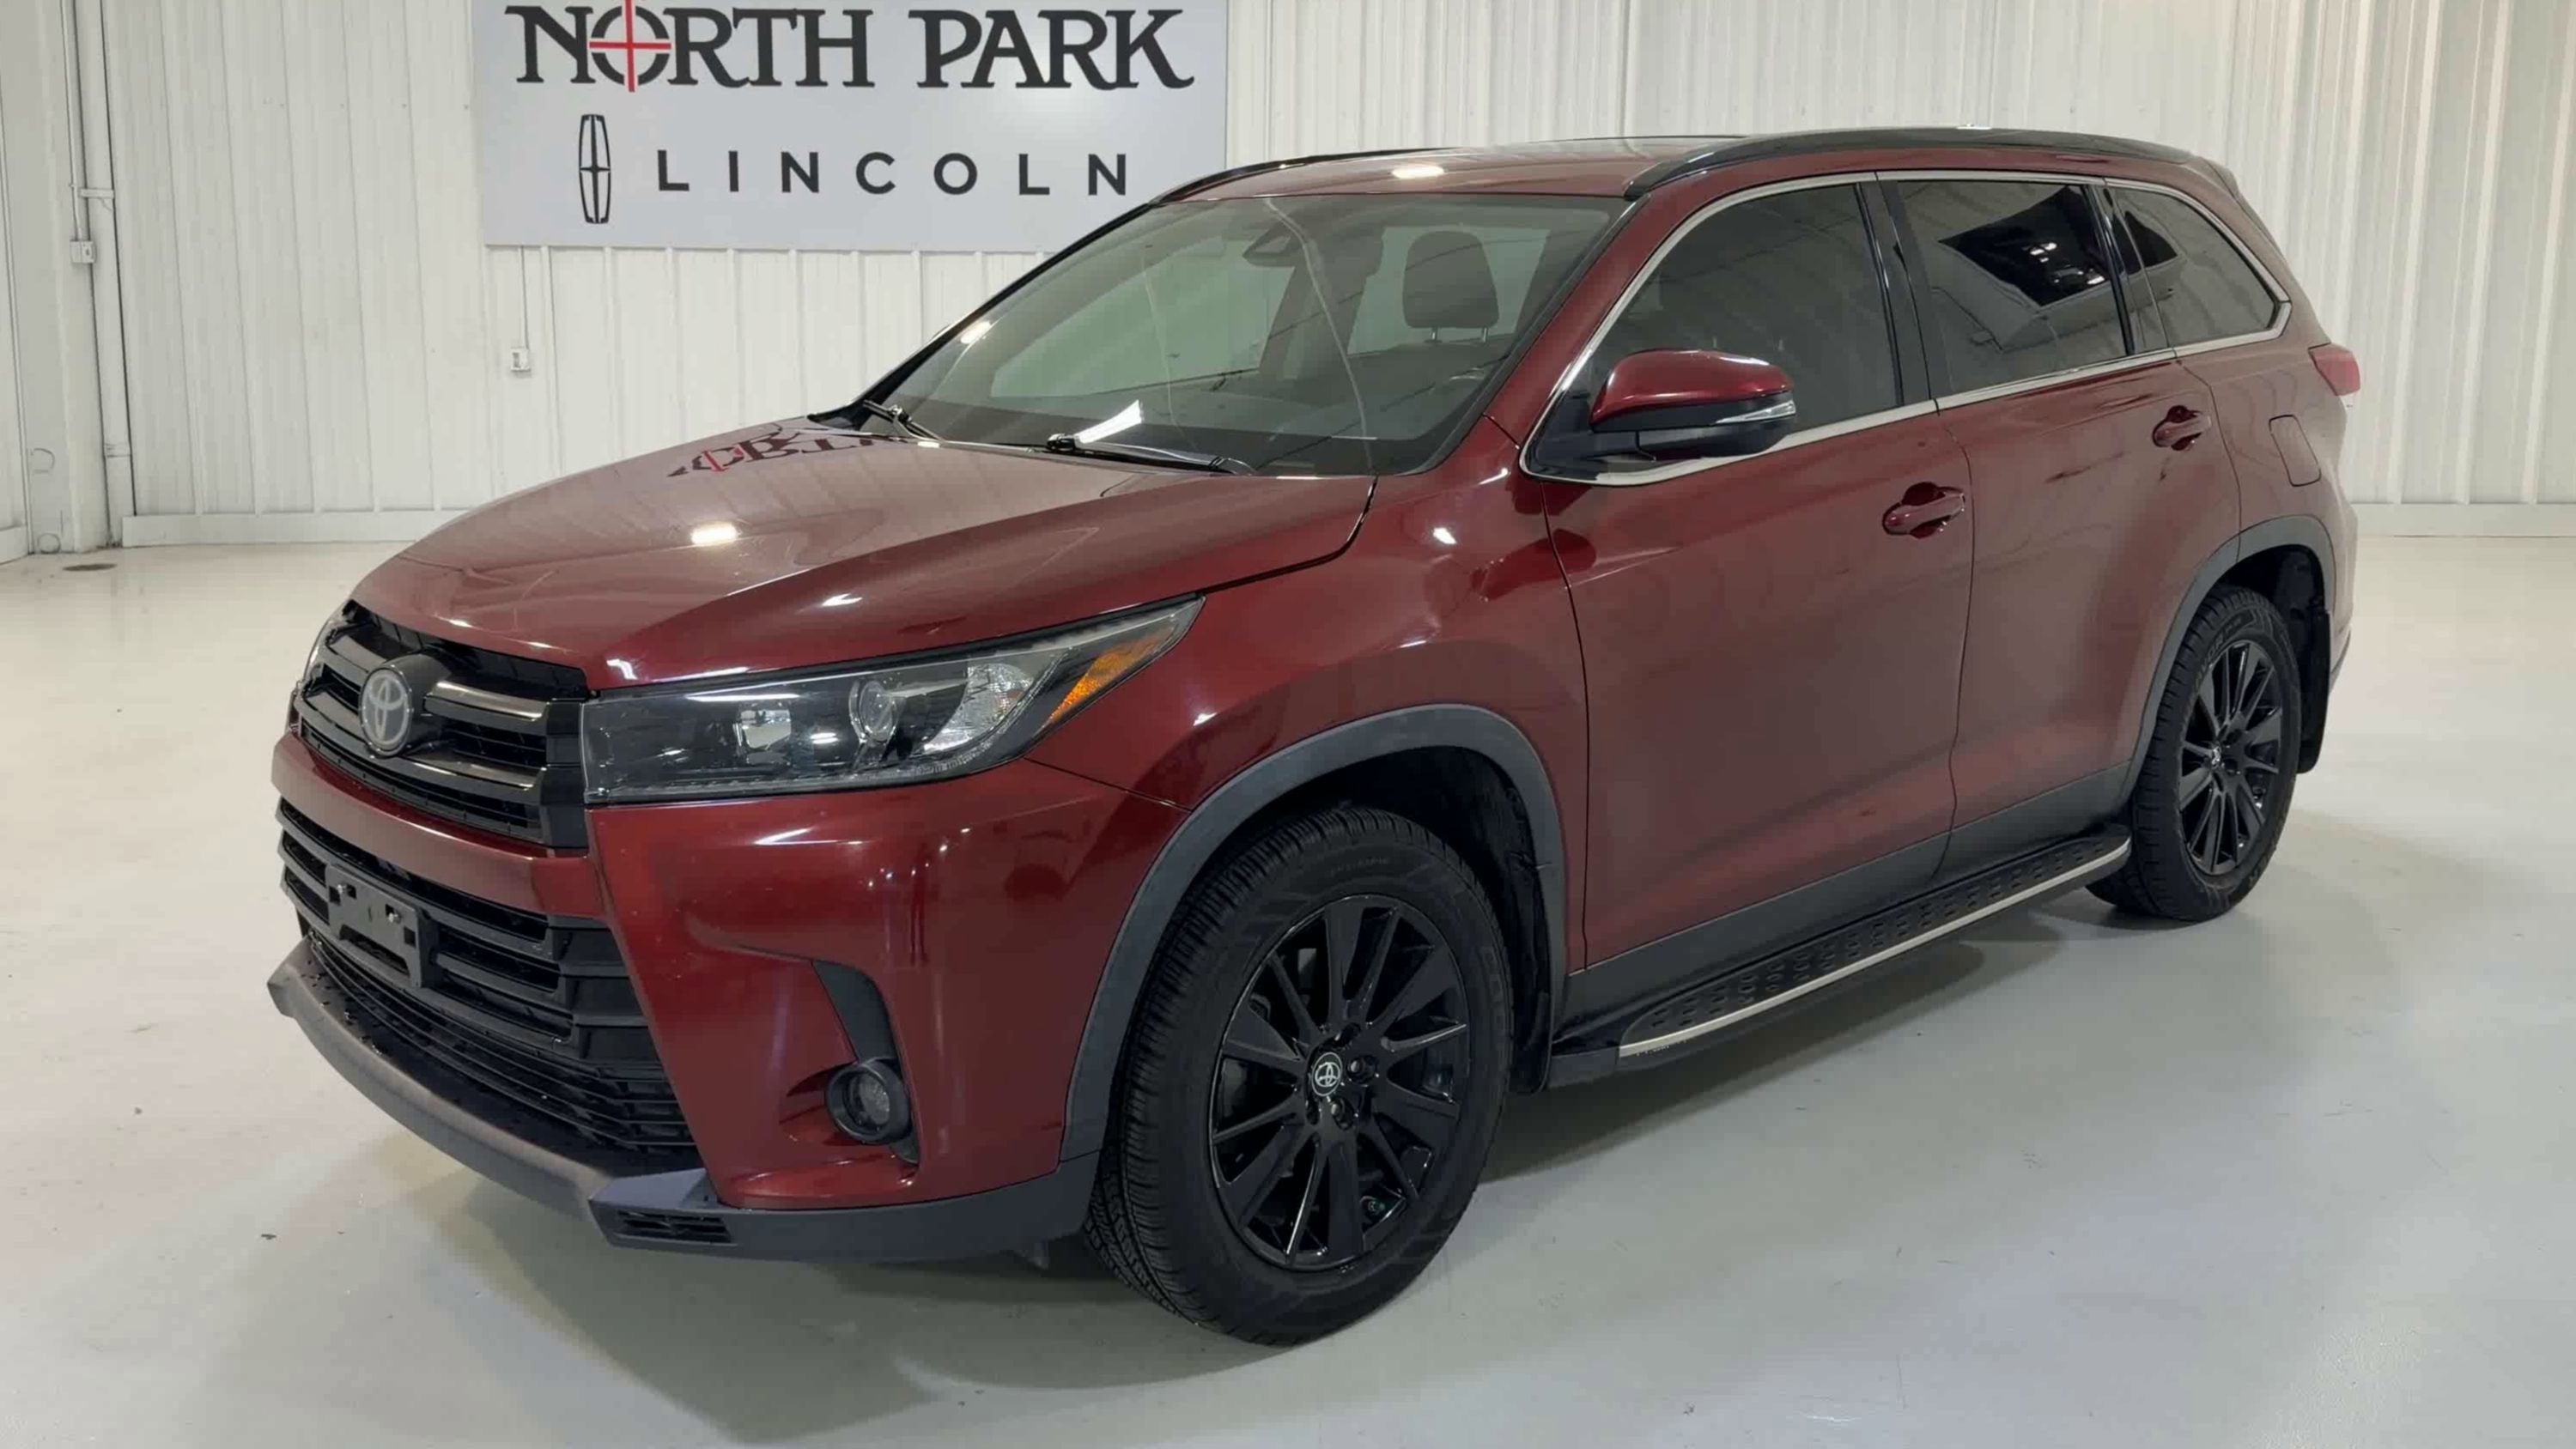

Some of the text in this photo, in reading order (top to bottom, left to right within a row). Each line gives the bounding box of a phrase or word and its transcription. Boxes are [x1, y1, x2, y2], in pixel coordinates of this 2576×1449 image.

[504, 2, 1194, 91] NORTH PARK
[657, 149, 1127, 196] LINCOLN
